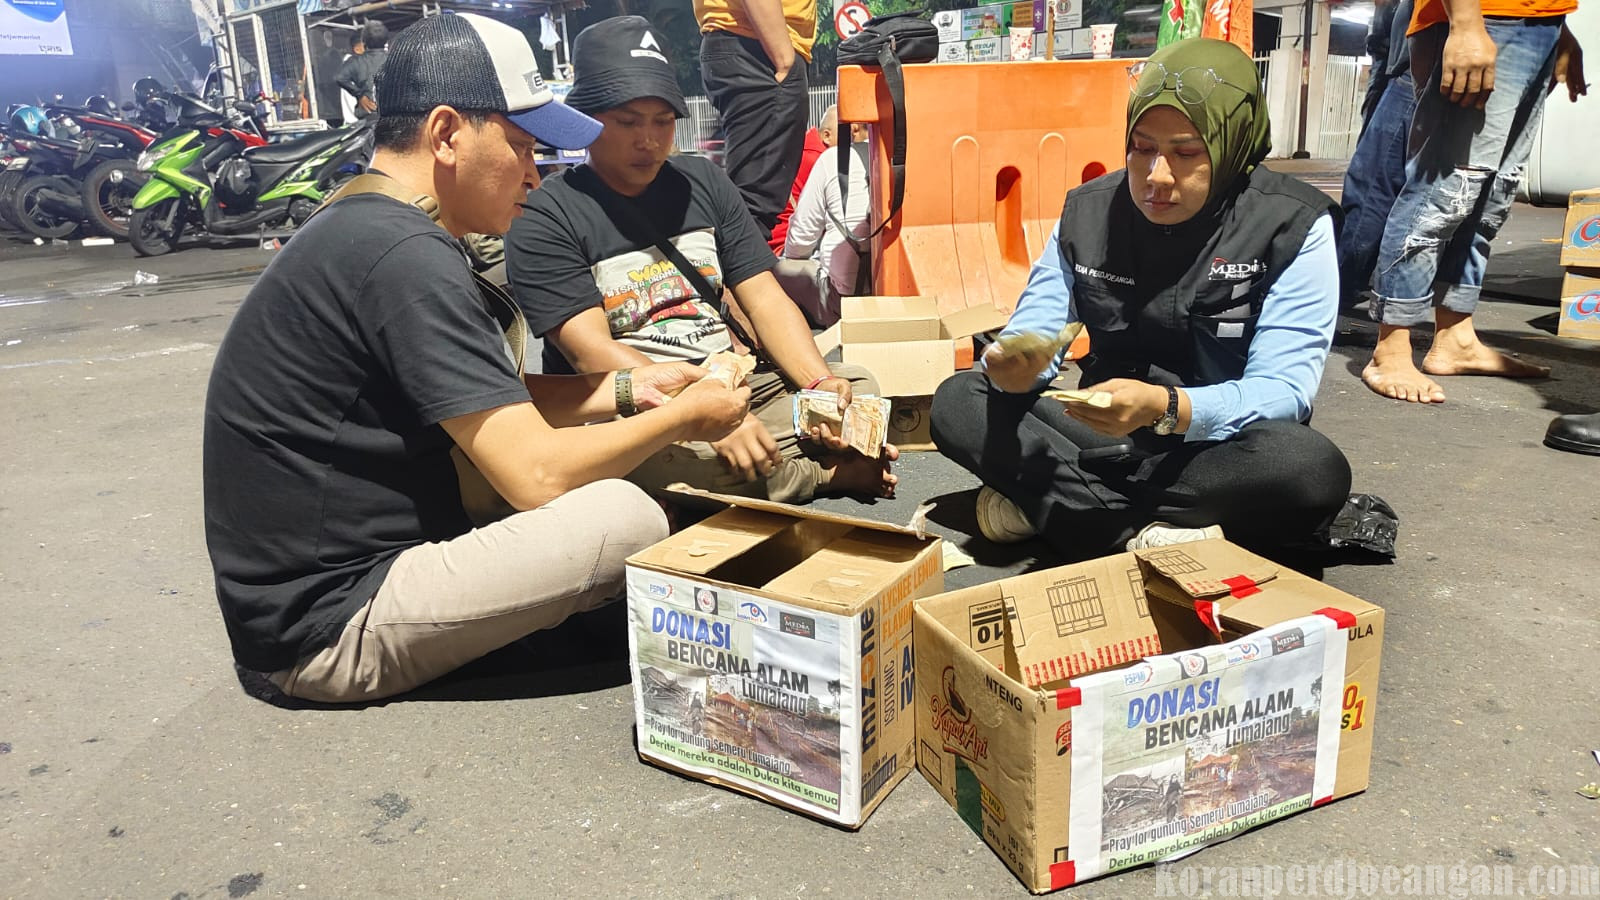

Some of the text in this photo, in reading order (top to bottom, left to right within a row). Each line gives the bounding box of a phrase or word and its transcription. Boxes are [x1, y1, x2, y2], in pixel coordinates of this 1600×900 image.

[914, 554, 938, 589] LEMON
[652, 607, 731, 650] DONASI
[977, 622, 1003, 644] 10
[1348, 624, 1374, 641] ULA
[667, 640, 809, 694] BENCANA ALAM
[861, 607, 876, 754] mizone
[884, 660, 895, 727] ISOTONIC
[983, 674, 1023, 712] NTENG
[742, 678, 807, 716] Lumajang
[1127, 676, 1221, 729] DONASI
[1145, 687, 1294, 750] BENCANA ALAM
[650, 717, 666, 735] Pray
[680, 731, 711, 750] gunung
[713, 738, 746, 759] Semeru
[748, 750, 791, 775] Lumajang
[1225, 713, 1290, 749] Lumajang
[649, 734, 838, 806] Derita mereka adalah Duka kita semua
[1109, 837, 1131, 852] Pray
[1150, 820, 1187, 843] gunung
[1189, 807, 1225, 830] Semeru
[1226, 792, 1270, 818] Lumajang
[1109, 797, 1310, 870] Derita mereka adalah Duka kita semua
